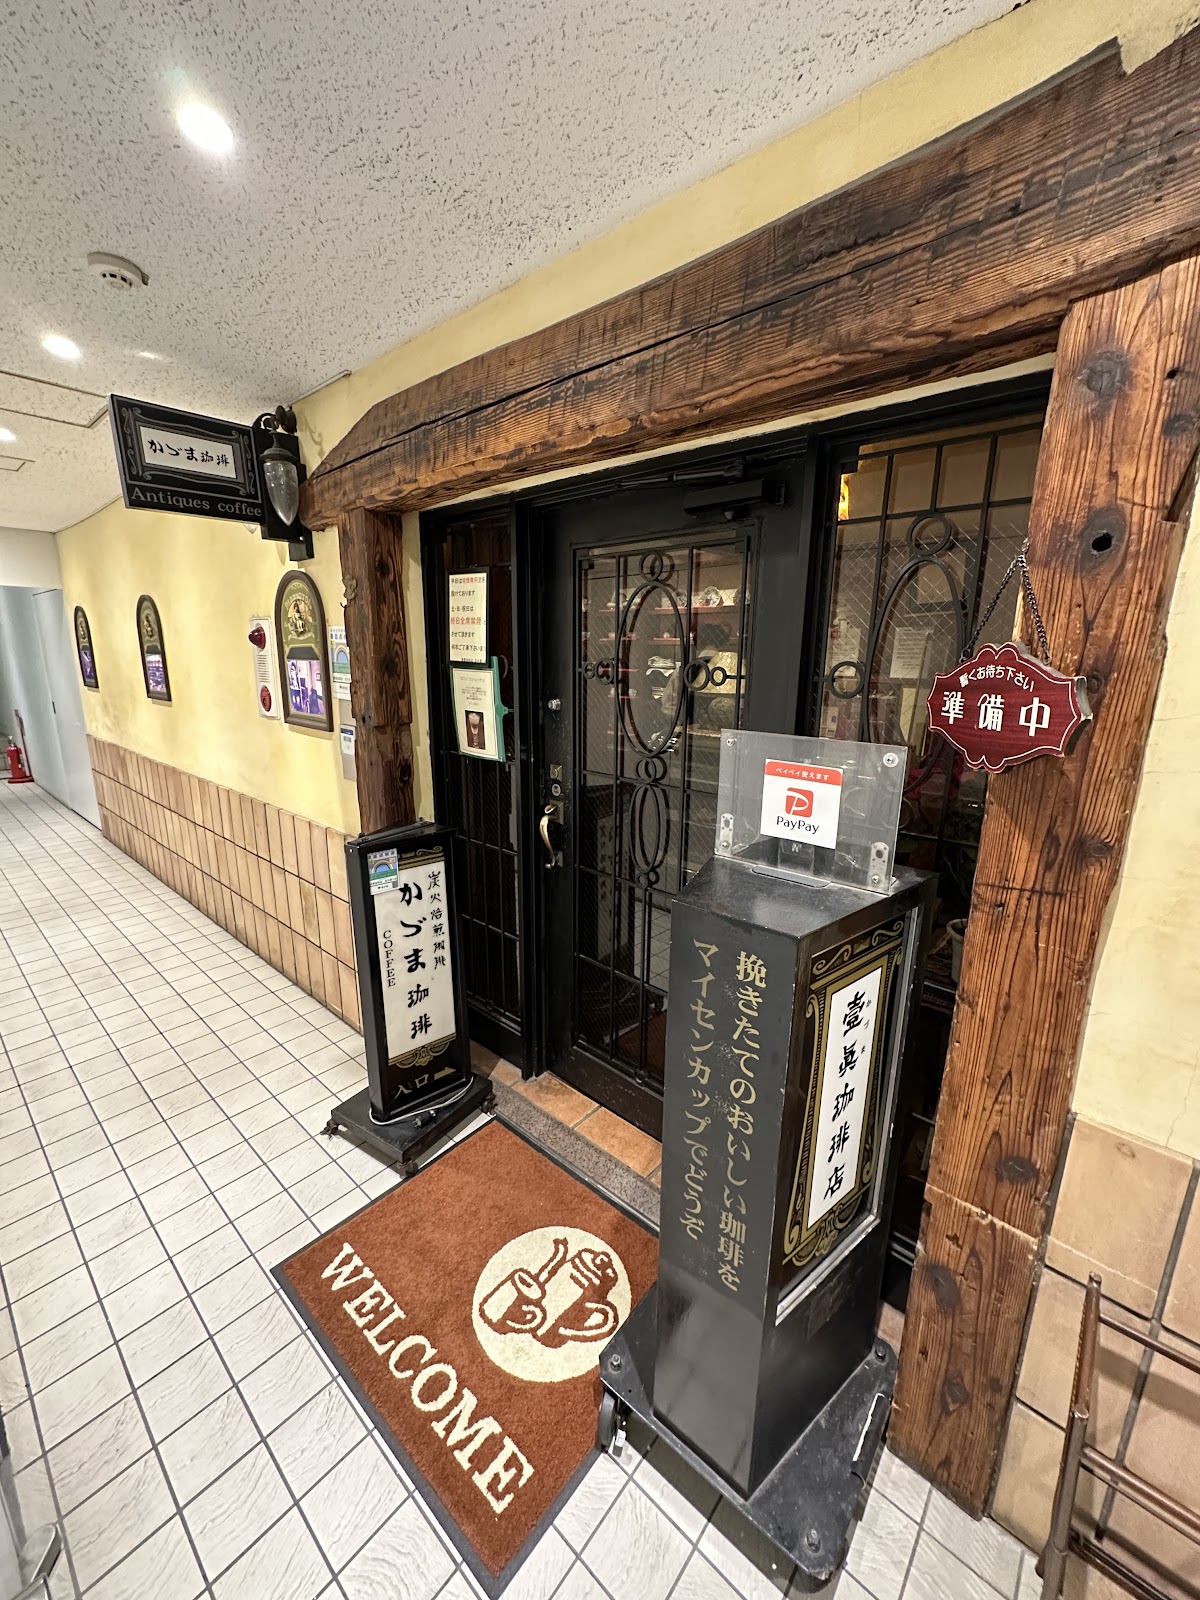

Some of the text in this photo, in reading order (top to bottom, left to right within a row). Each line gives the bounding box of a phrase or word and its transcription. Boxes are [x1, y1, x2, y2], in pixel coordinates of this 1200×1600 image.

[148, 438, 230, 467] かづま珈琲
[131, 487, 262, 516] Antiques coffee
[941, 691, 1051, 737] 準備中
[776, 767, 829, 781] ペイペイ使えます
[776, 815, 820, 834] PayPay
[383, 929, 396, 988] COFFEE
[398, 881, 433, 1039] かづま珈琲
[393, 1074, 429, 1100] 入口
[680, 938, 719, 1240] マイセンカップでどうぞ
[719, 950, 767, 1292] 挽きたてのおいしい珈琲を
[321, 1242, 535, 1515] WELCOME
